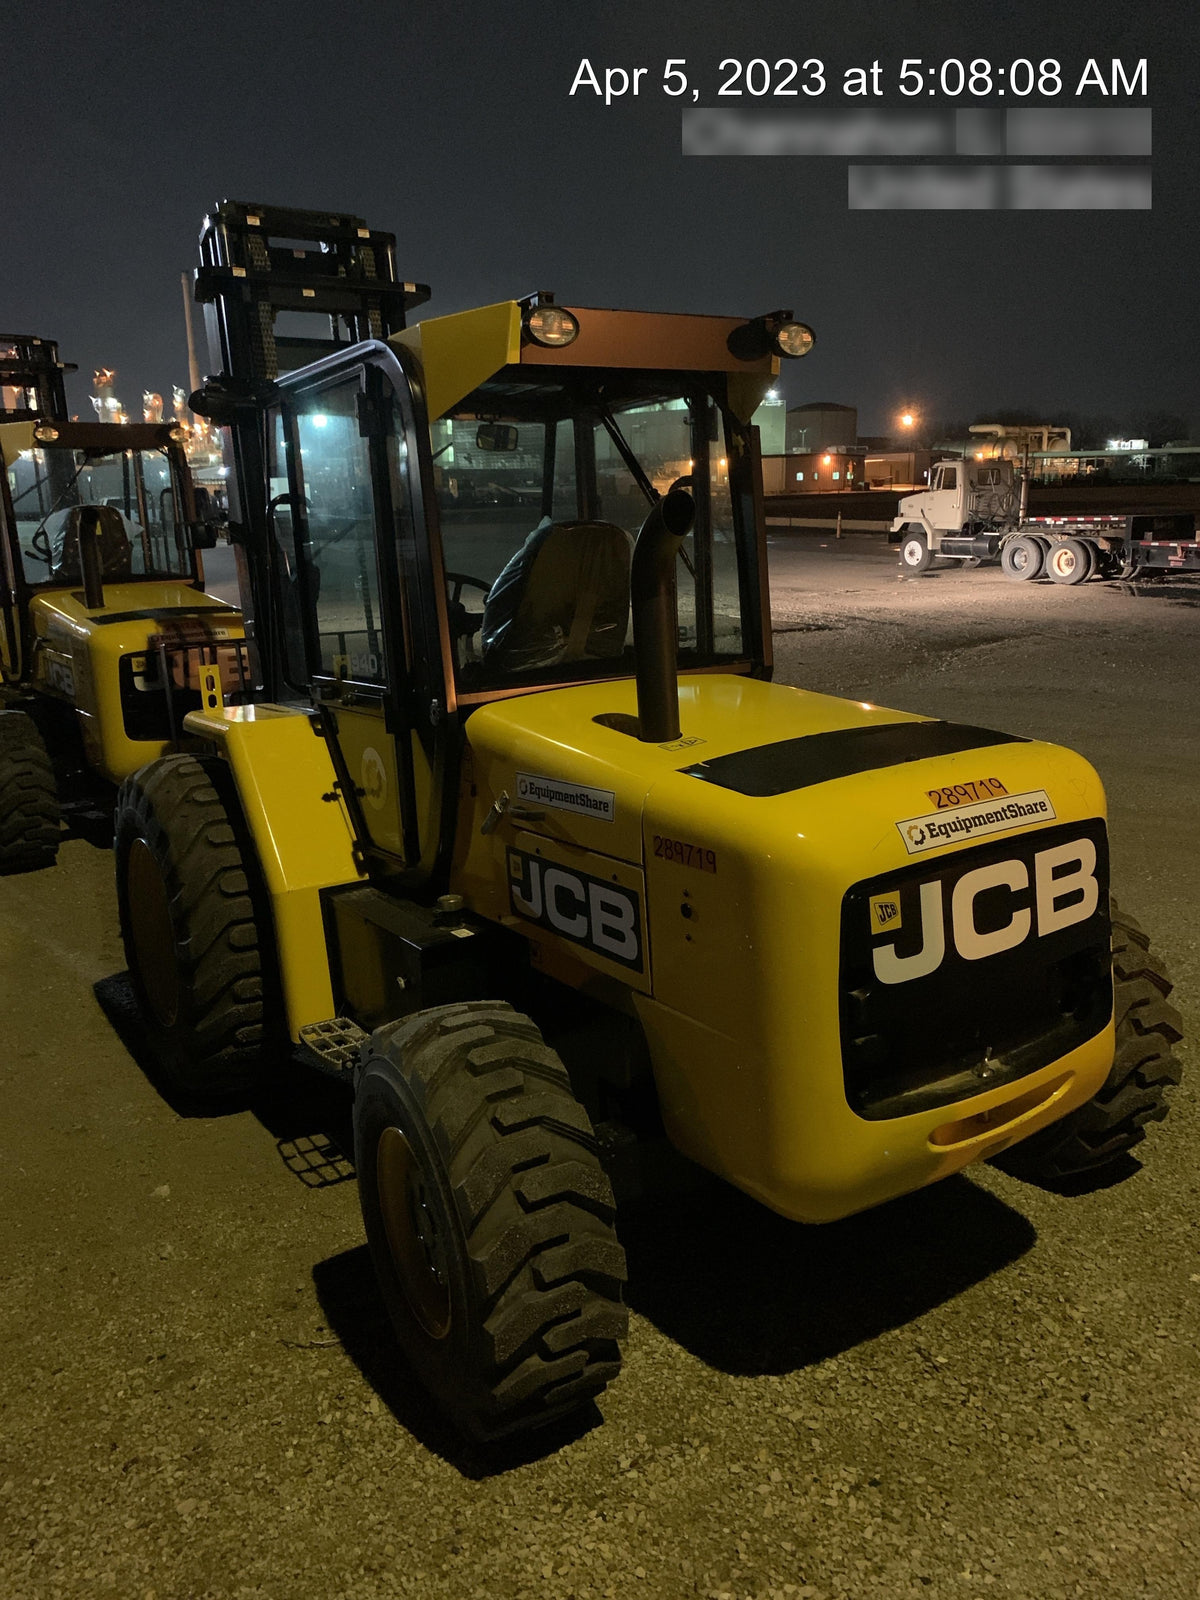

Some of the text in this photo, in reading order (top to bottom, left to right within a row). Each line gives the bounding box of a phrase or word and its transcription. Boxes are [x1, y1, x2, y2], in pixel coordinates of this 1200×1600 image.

[529, 782, 610, 812] EquipmentShare
[928, 777, 1008, 809] 289719
[925, 798, 1049, 840] EquipmentShare
[653, 835, 718, 874] 289719
[512, 860, 639, 962] JCB
[872, 837, 1100, 985] JCB
[878, 903, 897, 922] JCB
